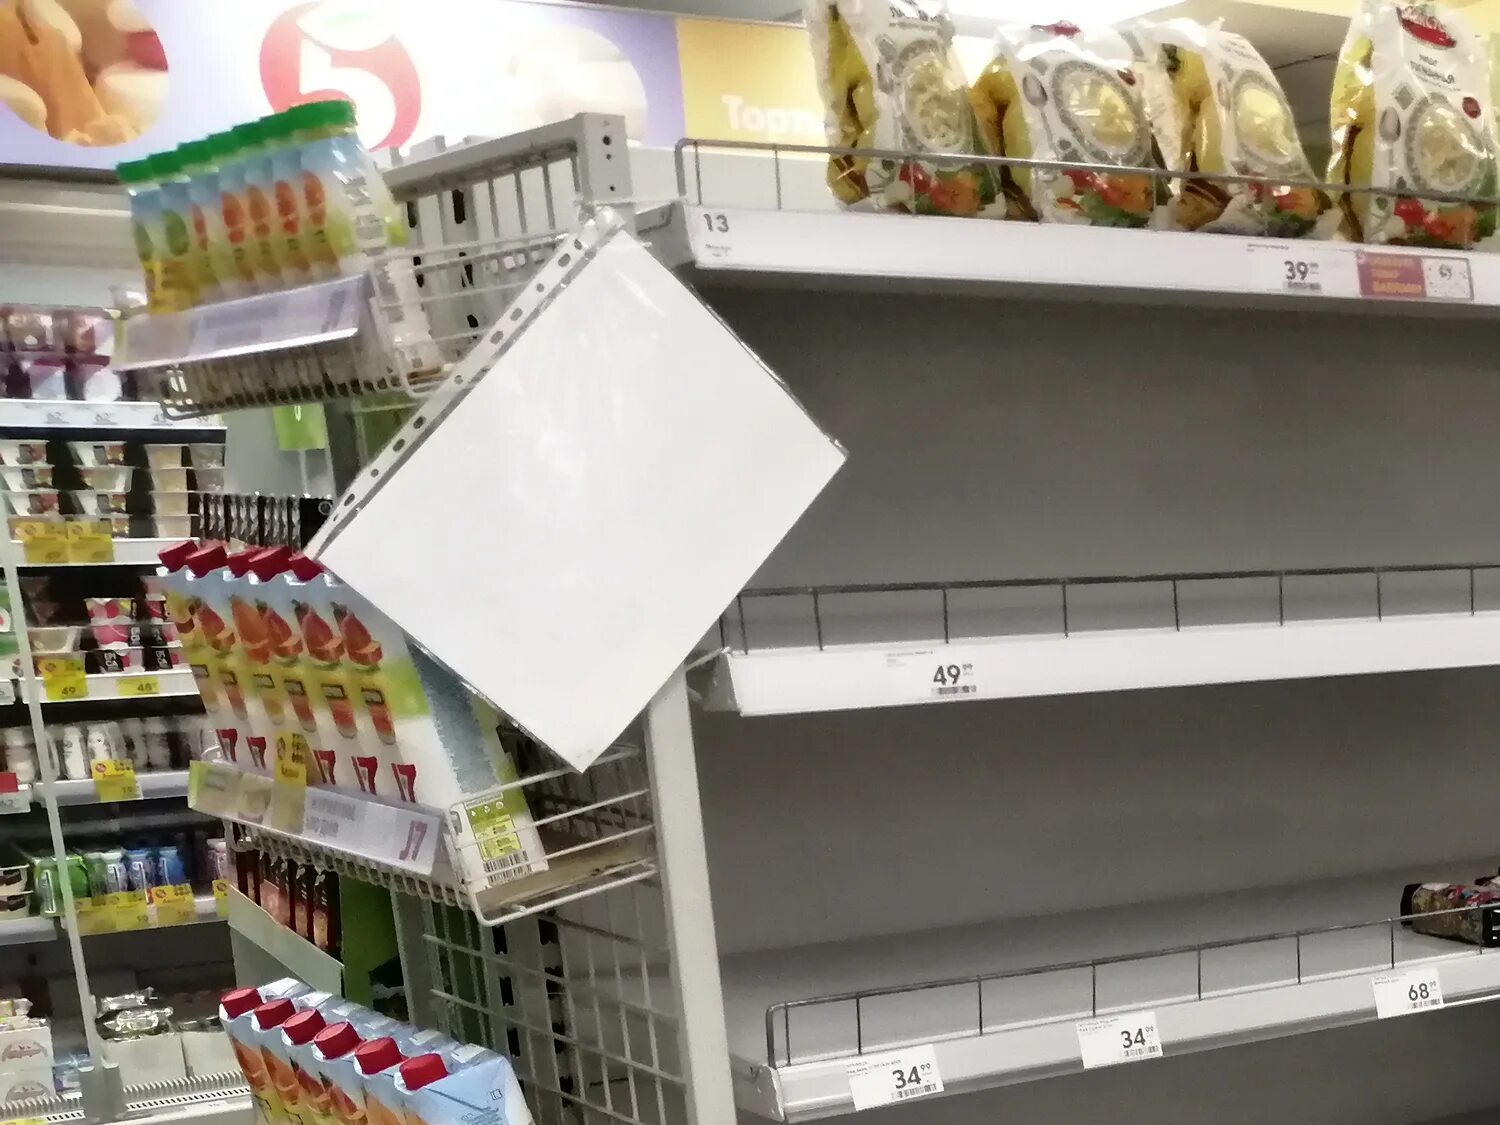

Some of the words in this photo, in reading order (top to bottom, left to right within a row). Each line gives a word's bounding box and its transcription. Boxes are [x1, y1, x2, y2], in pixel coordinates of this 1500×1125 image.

[704, 214, 729, 233] 13
[1284, 260, 1309, 281] 39
[933, 664, 960, 687] 49
[1408, 982, 1430, 1001] 68
[1121, 1028, 1146, 1049] 34
[892, 1065, 921, 1089] 34
